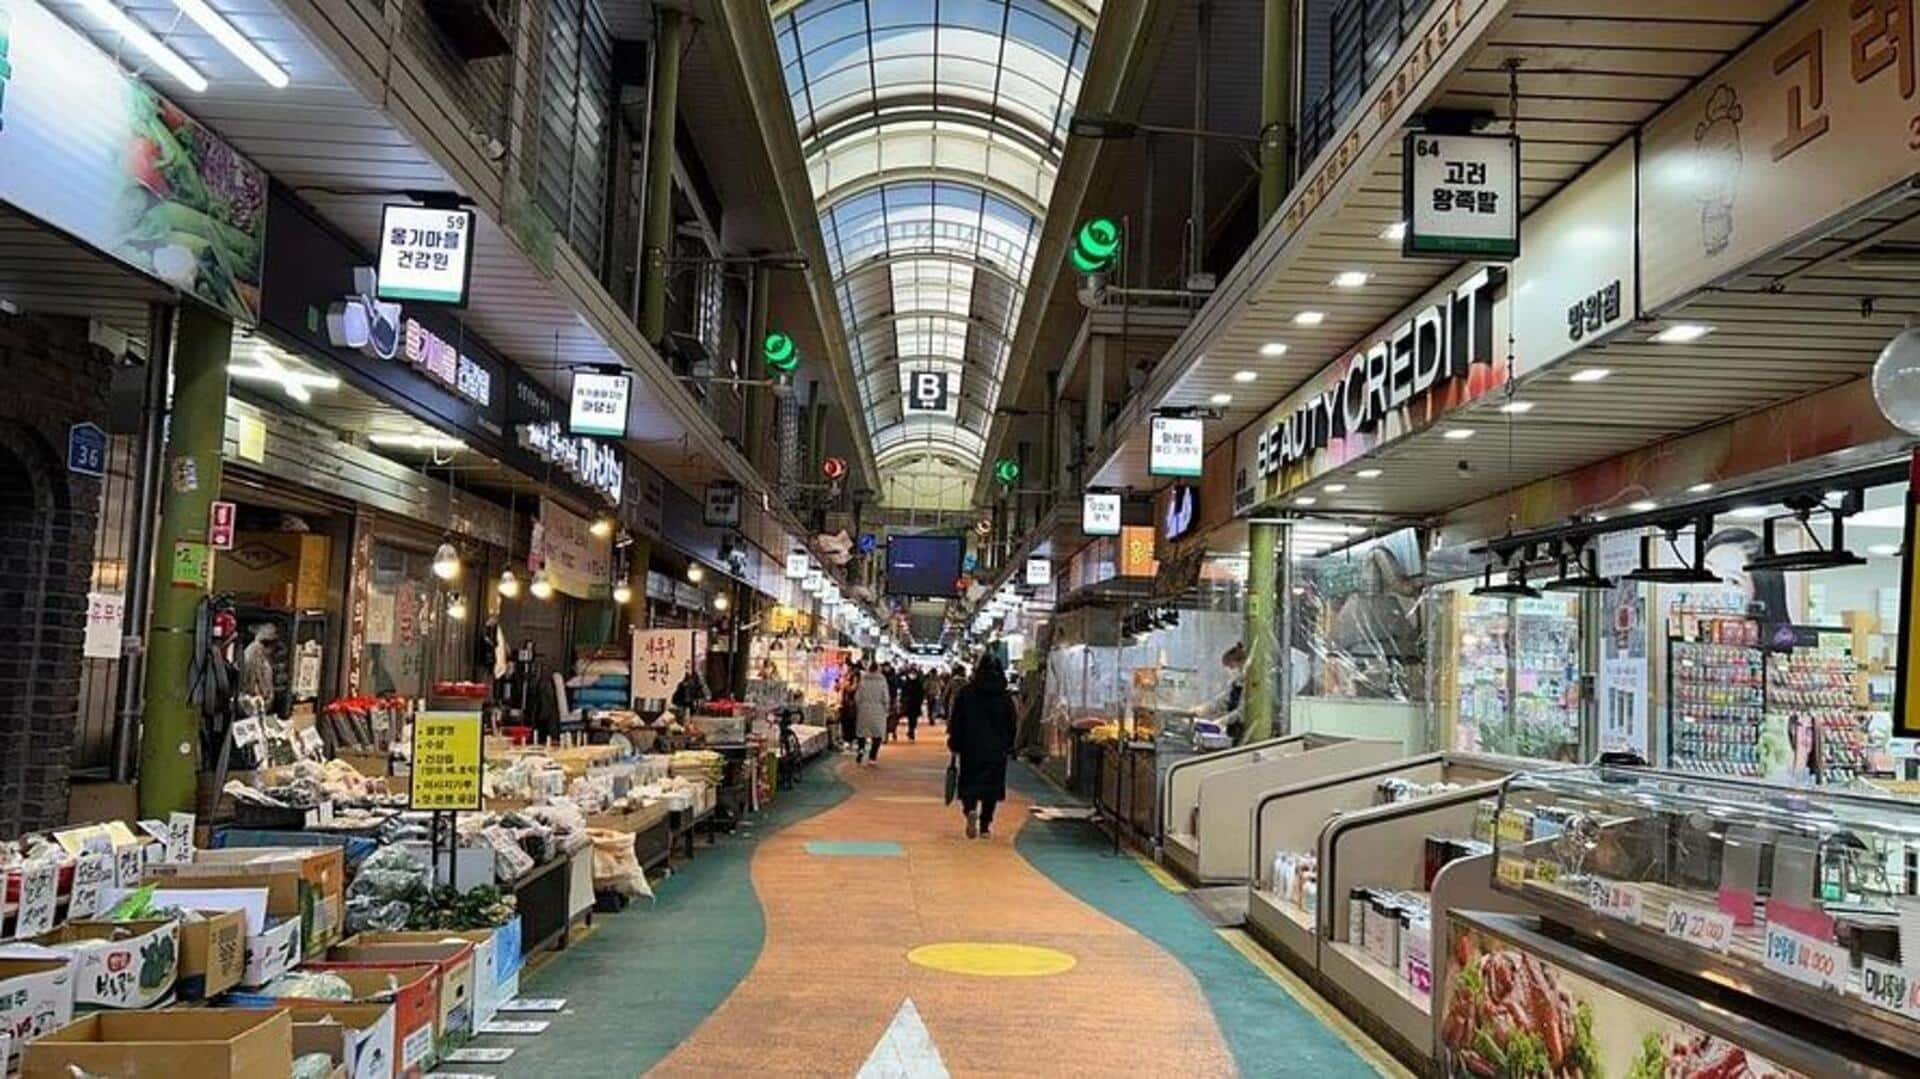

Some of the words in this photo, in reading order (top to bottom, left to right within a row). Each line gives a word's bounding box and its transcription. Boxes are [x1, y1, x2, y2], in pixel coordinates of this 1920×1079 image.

[1416, 140, 1439, 157] 64
[1444, 161, 1486, 185] 고려
[1432, 188, 1498, 214] 왕족발
[446, 215, 465, 230] 59
[397, 249, 449, 271] 건강원
[1568, 280, 1621, 341] 망원점
[917, 373, 940, 401] B
[78, 445, 99, 468] 36
